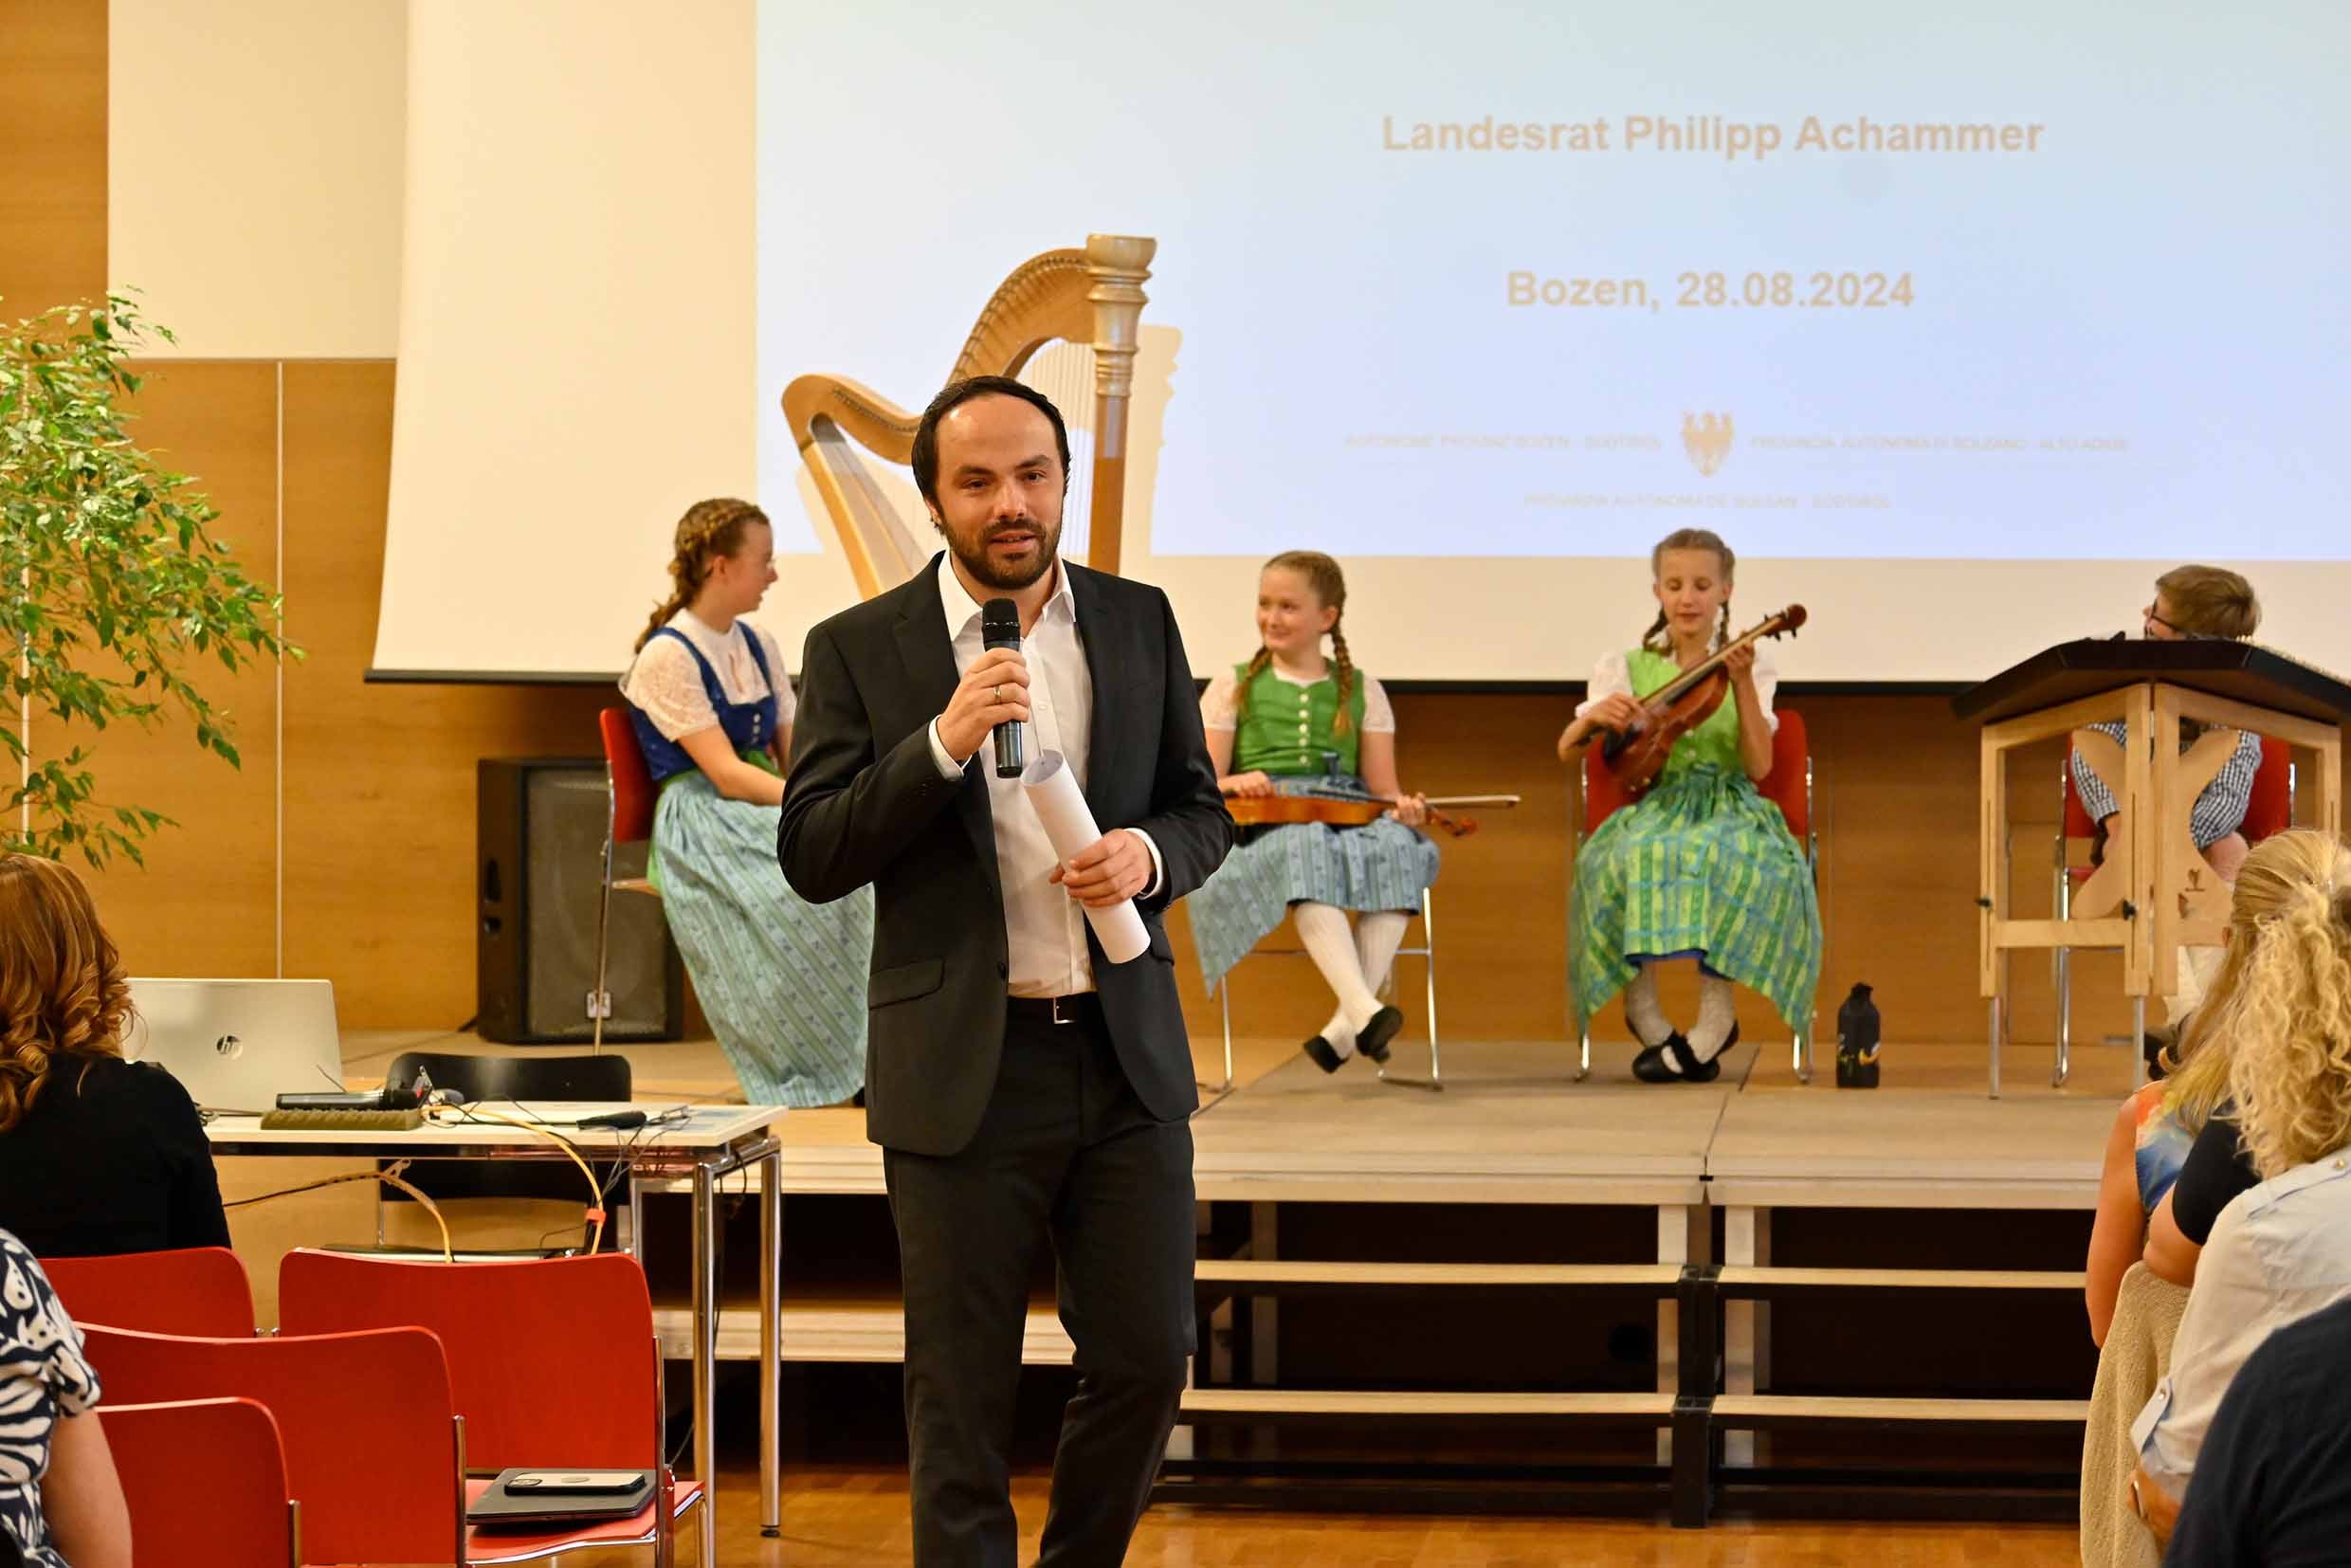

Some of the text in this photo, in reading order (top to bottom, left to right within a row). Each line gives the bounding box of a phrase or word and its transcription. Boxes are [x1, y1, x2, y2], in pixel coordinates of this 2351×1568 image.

[1383, 116, 2045, 161] Landesrat Philipp Achammer
[1508, 271, 1915, 313] Bozen, 28.08.2024
[216, 1033, 242, 1059] hp
